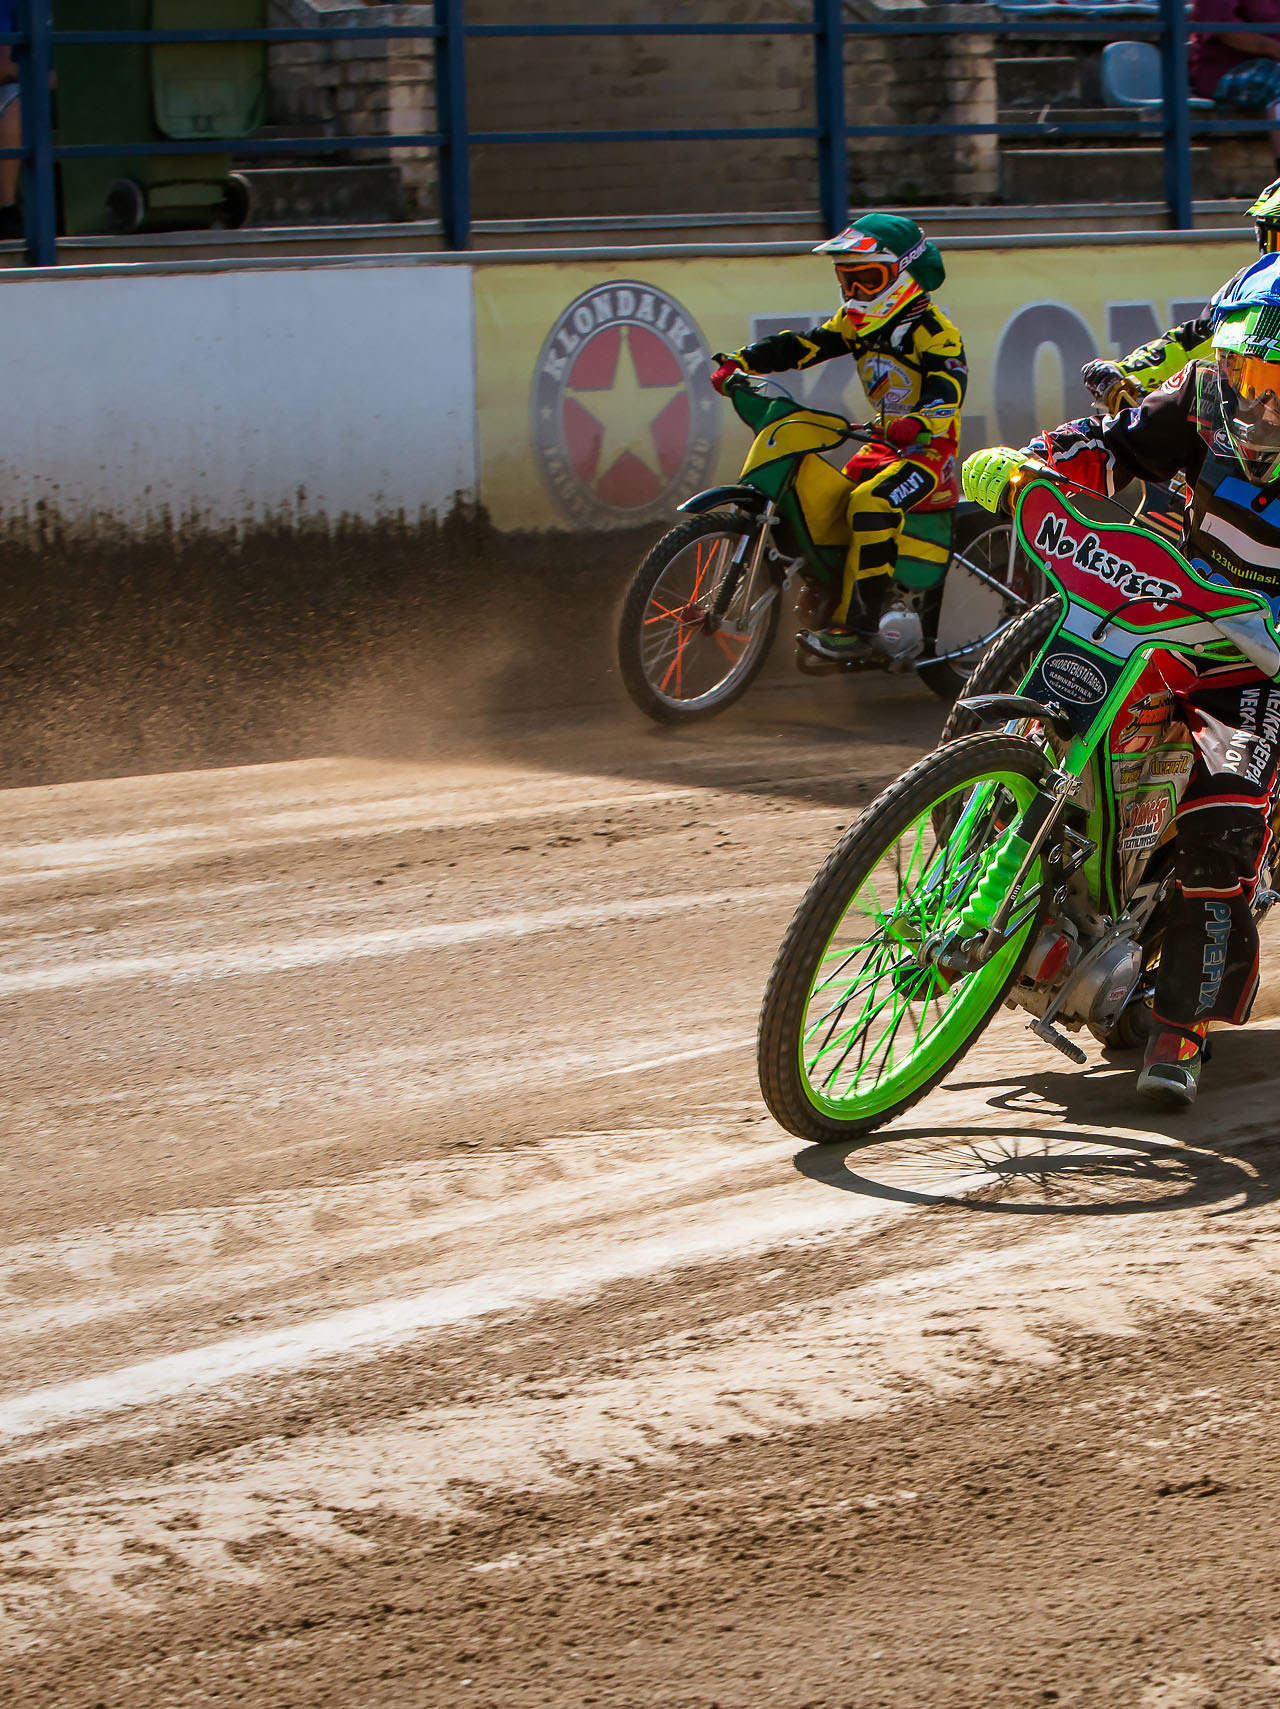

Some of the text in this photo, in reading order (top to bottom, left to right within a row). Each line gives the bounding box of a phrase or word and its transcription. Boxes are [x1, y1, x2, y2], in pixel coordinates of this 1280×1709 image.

[543, 290, 703, 381] KLONDAIKA
[1073, 532, 1182, 611] RESPECT
[1222, 749, 1242, 773] OY
